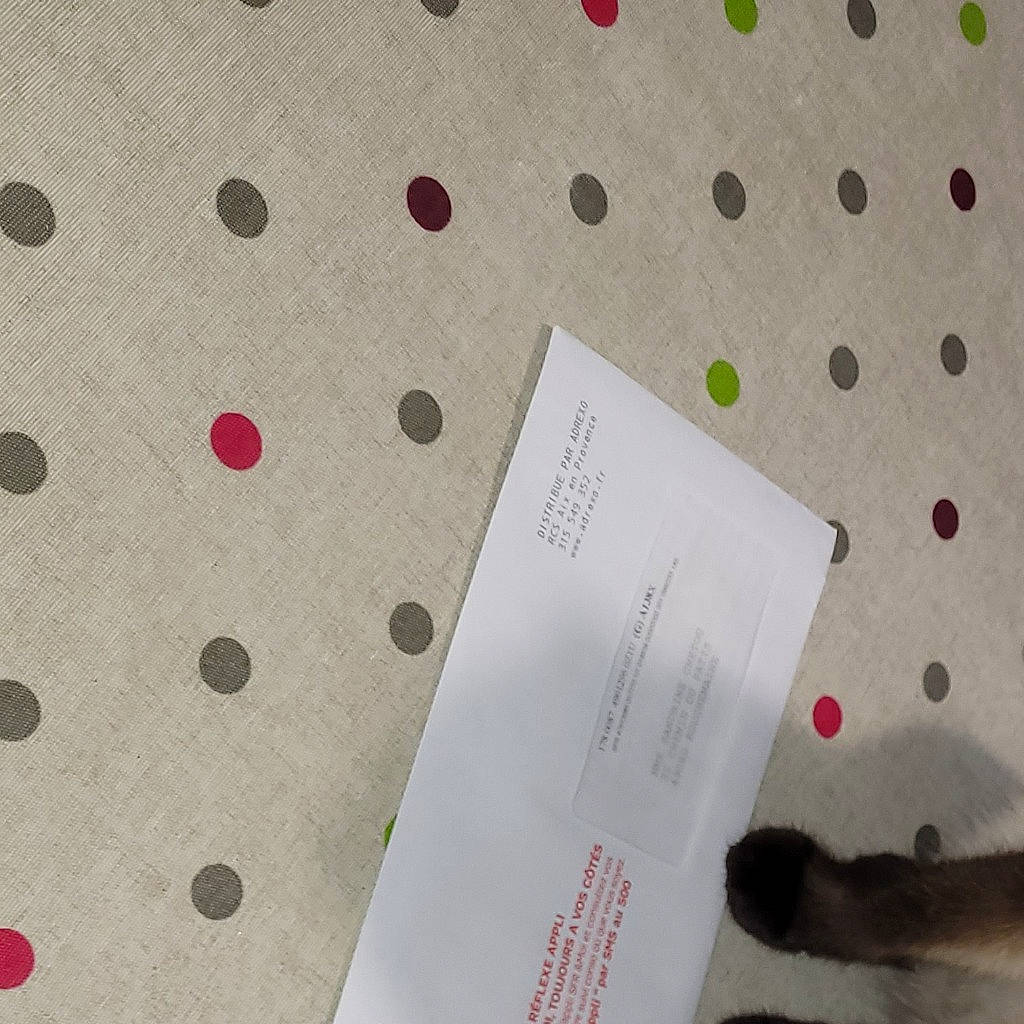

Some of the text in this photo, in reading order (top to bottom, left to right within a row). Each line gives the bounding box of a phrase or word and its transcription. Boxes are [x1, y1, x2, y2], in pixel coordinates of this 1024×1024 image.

[538, 400, 588, 539] DISTRIBUE PAR ADREXO
[548, 414, 596, 546] RCS Aix en Provence
[559, 474, 591, 551] 315 549 352
[548, 938, 575, 1011] TOUJOURS
[573, 891, 588, 921] VOS
[582, 843, 603, 889] CÔTÉS
[614, 910, 624, 928] au
[617, 879, 632, 907] 500
[527, 959, 553, 1021] RÉFLEXE
[547, 915, 564, 955] APPLI
[597, 964, 611, 988] par
[603, 931, 617, 959] SMS
